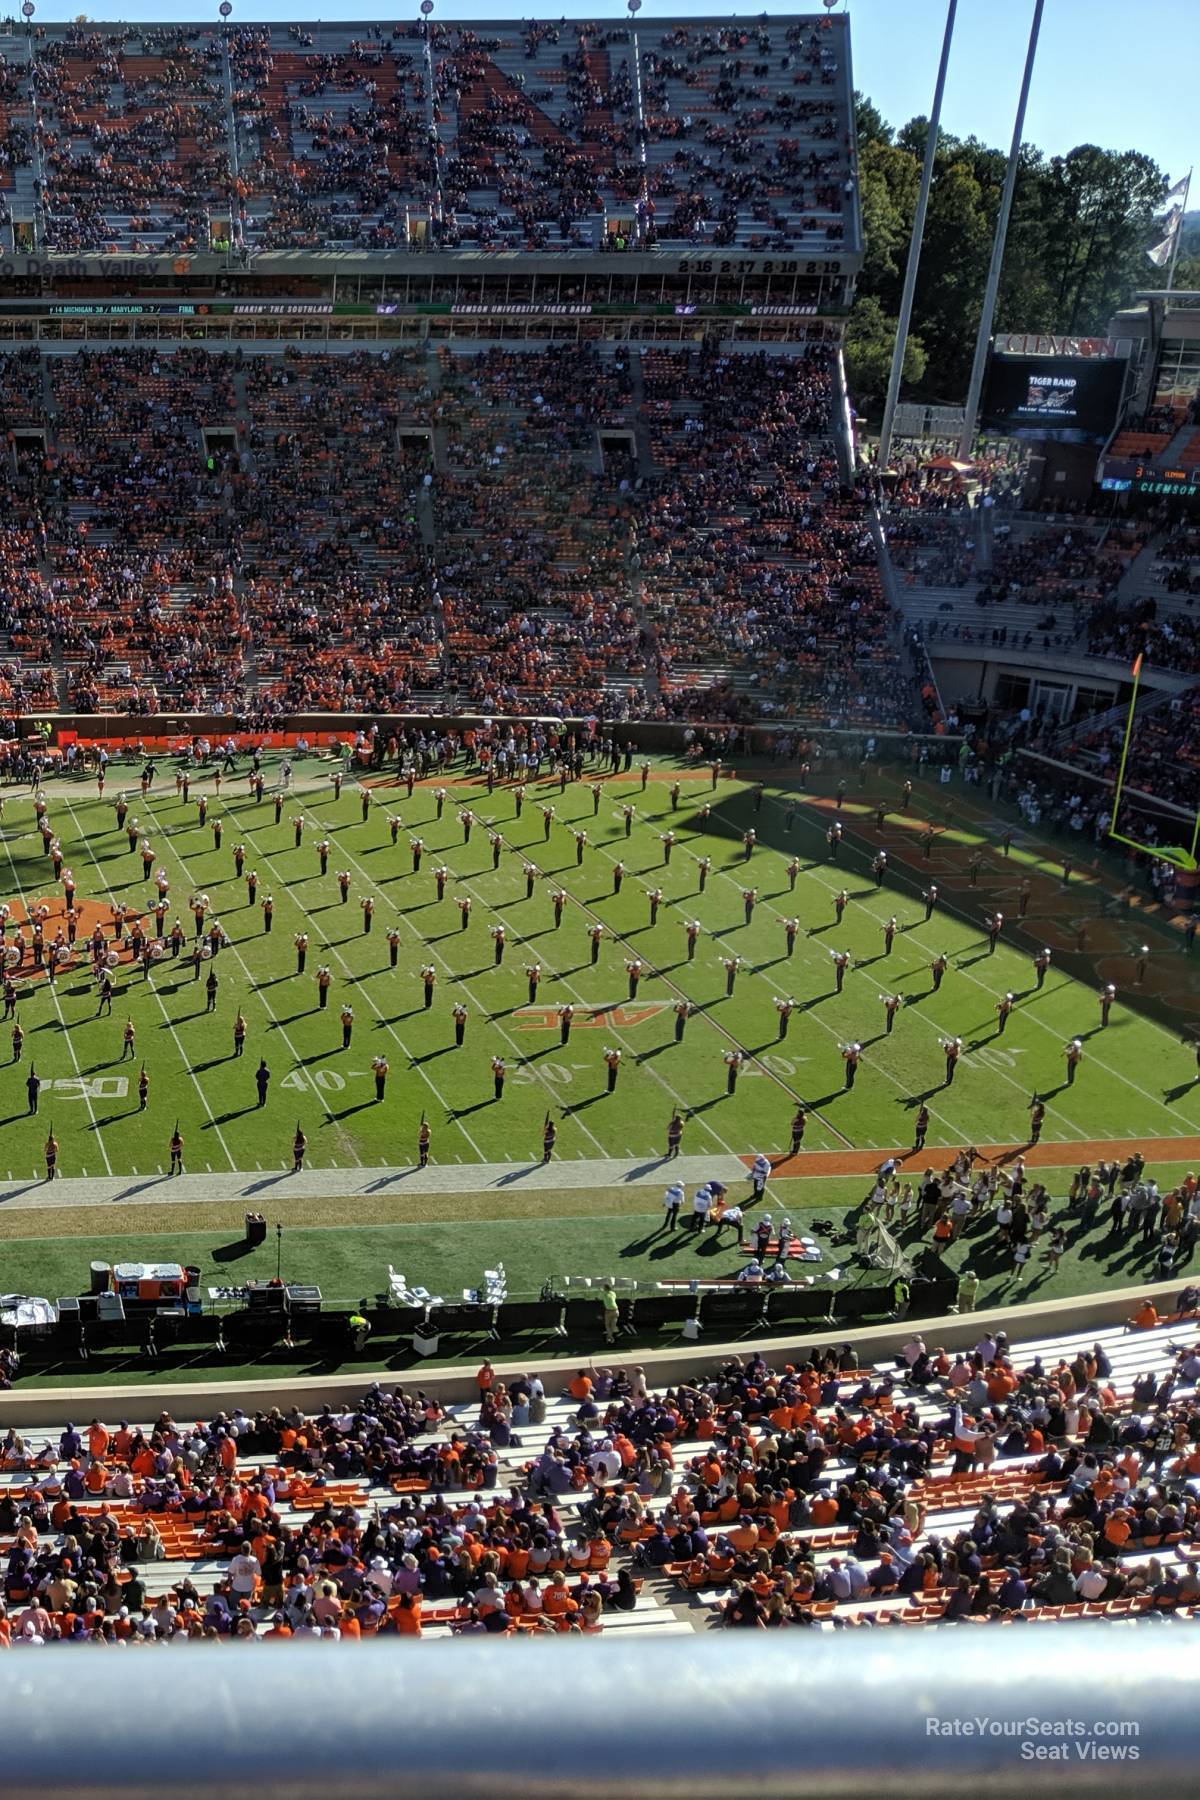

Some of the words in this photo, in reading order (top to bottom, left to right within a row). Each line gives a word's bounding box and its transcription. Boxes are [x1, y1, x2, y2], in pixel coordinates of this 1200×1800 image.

[26, 259, 87, 276] Death
[100, 259, 159, 278] Valley
[64, 306, 93, 314] MICHIGAN
[111, 305, 143, 313] MARYLAND
[178, 305, 195, 314] FINAL
[233, 305, 267, 314] SHAKIN'
[269, 305, 284, 314] THE
[287, 305, 334, 314] SOUTHLAND
[451, 305, 488, 313] CLEMSON
[490, 305, 540, 313] UNIVERSITY
[542, 304, 567, 313] TIGER
[569, 304, 593, 313] BAND
[750, 306, 818, 315] @CUTIGERBAND
[1029, 376, 1052, 386] TIGER
[1052, 378, 1077, 387] BAND
[1135, 467, 1143, 478] 3
[1140, 482, 1197, 496] CLEMSON
[504, 1062, 573, 1086] 30
[280, 1069, 347, 1092] 40
